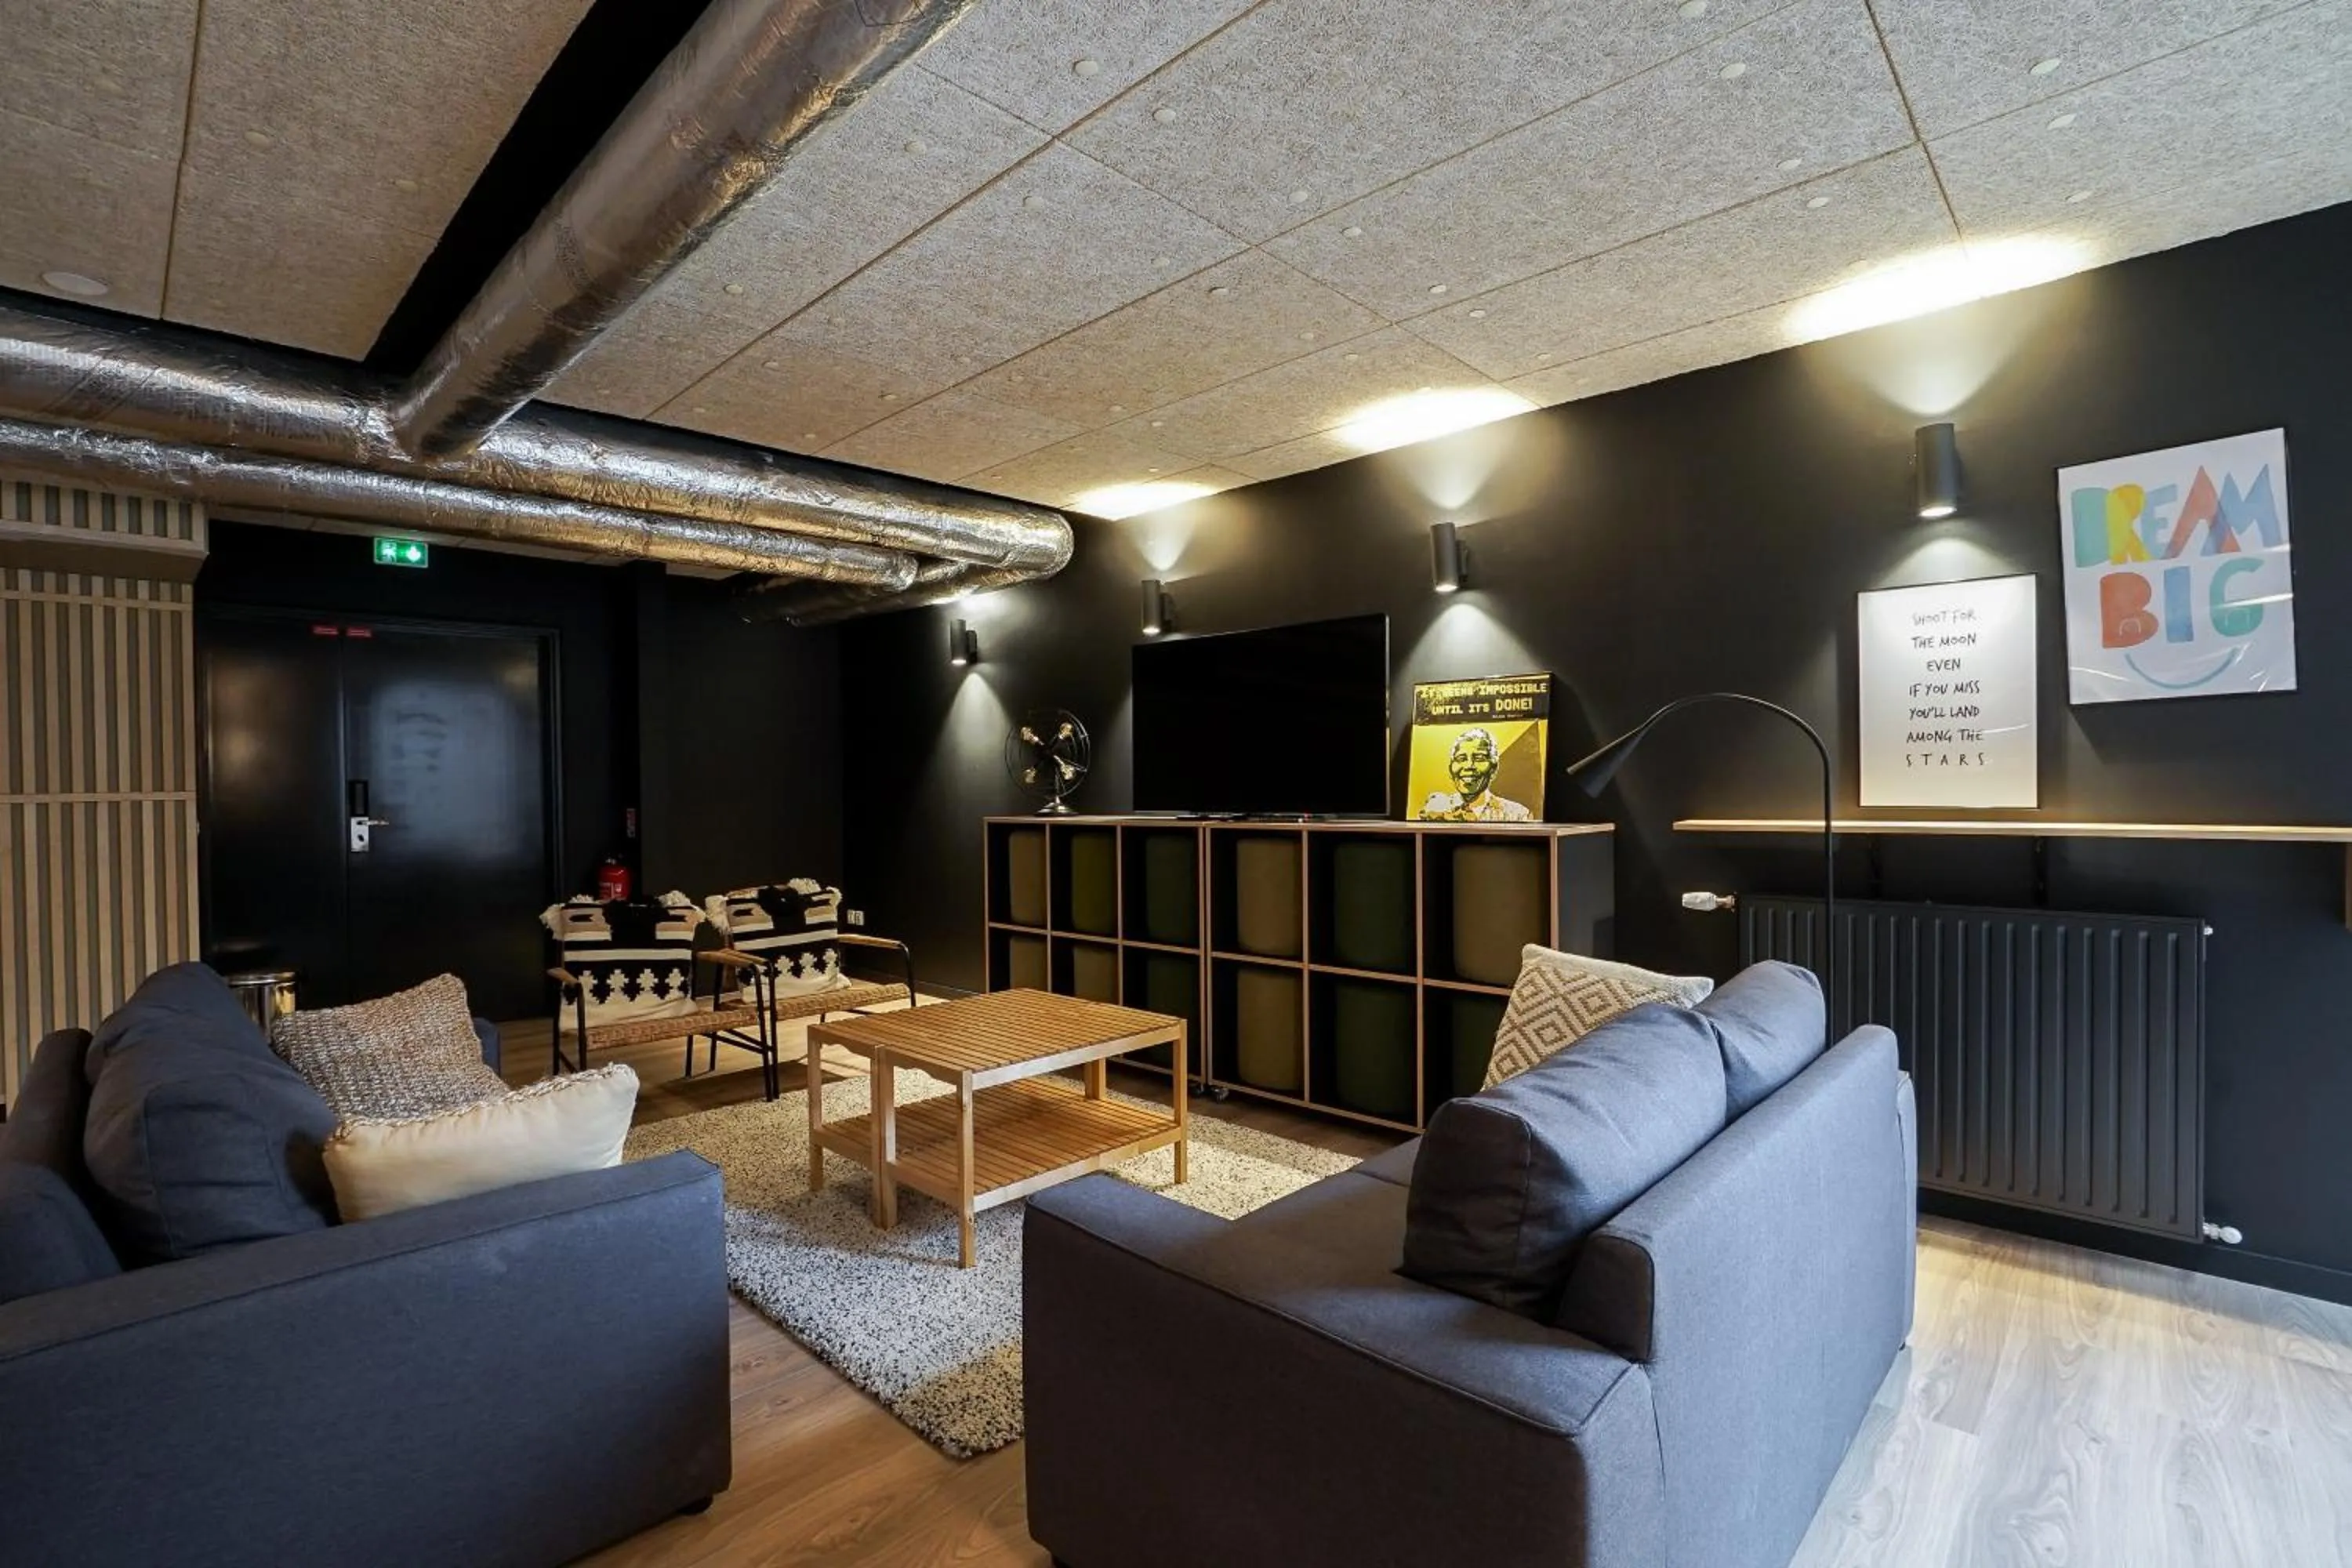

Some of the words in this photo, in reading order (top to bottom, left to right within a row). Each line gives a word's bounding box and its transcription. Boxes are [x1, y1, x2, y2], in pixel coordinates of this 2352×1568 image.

[2071, 463, 2281, 568] DREAM
[2100, 557, 2265, 648] BIG
[1952, 609, 1976, 624] FOR
[1911, 636, 1934, 649] THE
[1939, 632, 1976, 647] MOON
[1926, 658, 1961, 672] EVEN
[1479, 683, 1548, 696] IMPOSSIBLE
[1909, 683, 1922, 697] IF
[1925, 683, 1948, 696] YOU
[1953, 680, 1980, 695] MISS
[1432, 704, 1464, 715] UNTIL
[1495, 697, 1533, 712] DONE!
[1909, 706, 1945, 720] YOU'LL
[1950, 705, 1980, 719] LAND
[1906, 730, 1952, 744] AMONG
[1957, 728, 1984, 742] THE
[1906, 753, 1984, 767] STARS
